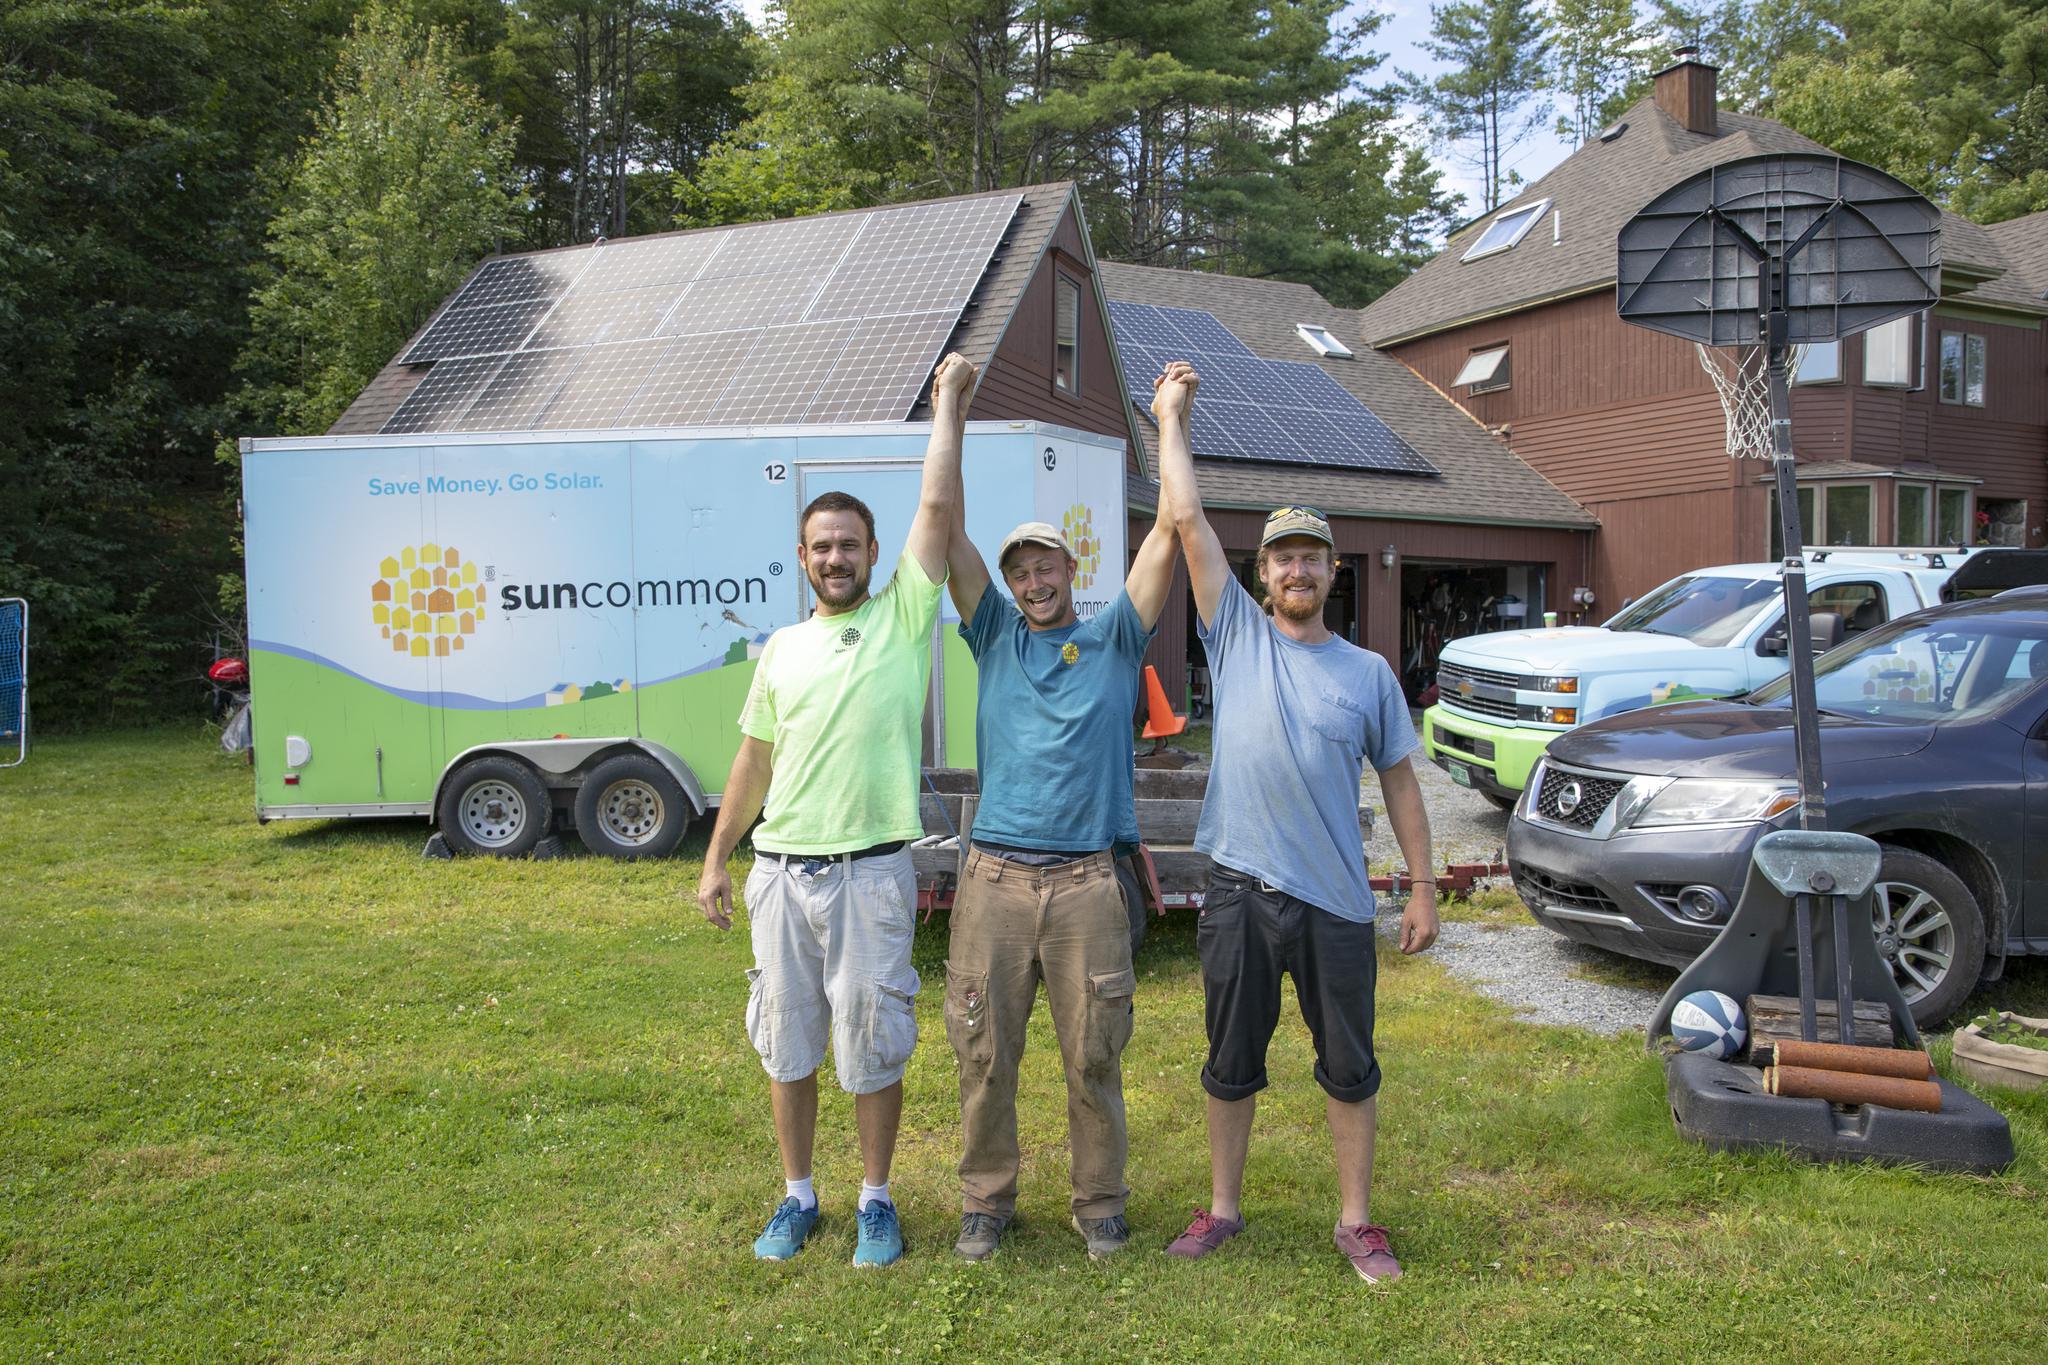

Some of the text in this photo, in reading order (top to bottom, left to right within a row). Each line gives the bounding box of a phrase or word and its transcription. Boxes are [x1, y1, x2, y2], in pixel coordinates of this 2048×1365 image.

[1045, 450, 1056, 468] 12
[764, 464, 786, 481] 12
[367, 471, 604, 497] Save Money. Go Solar.
